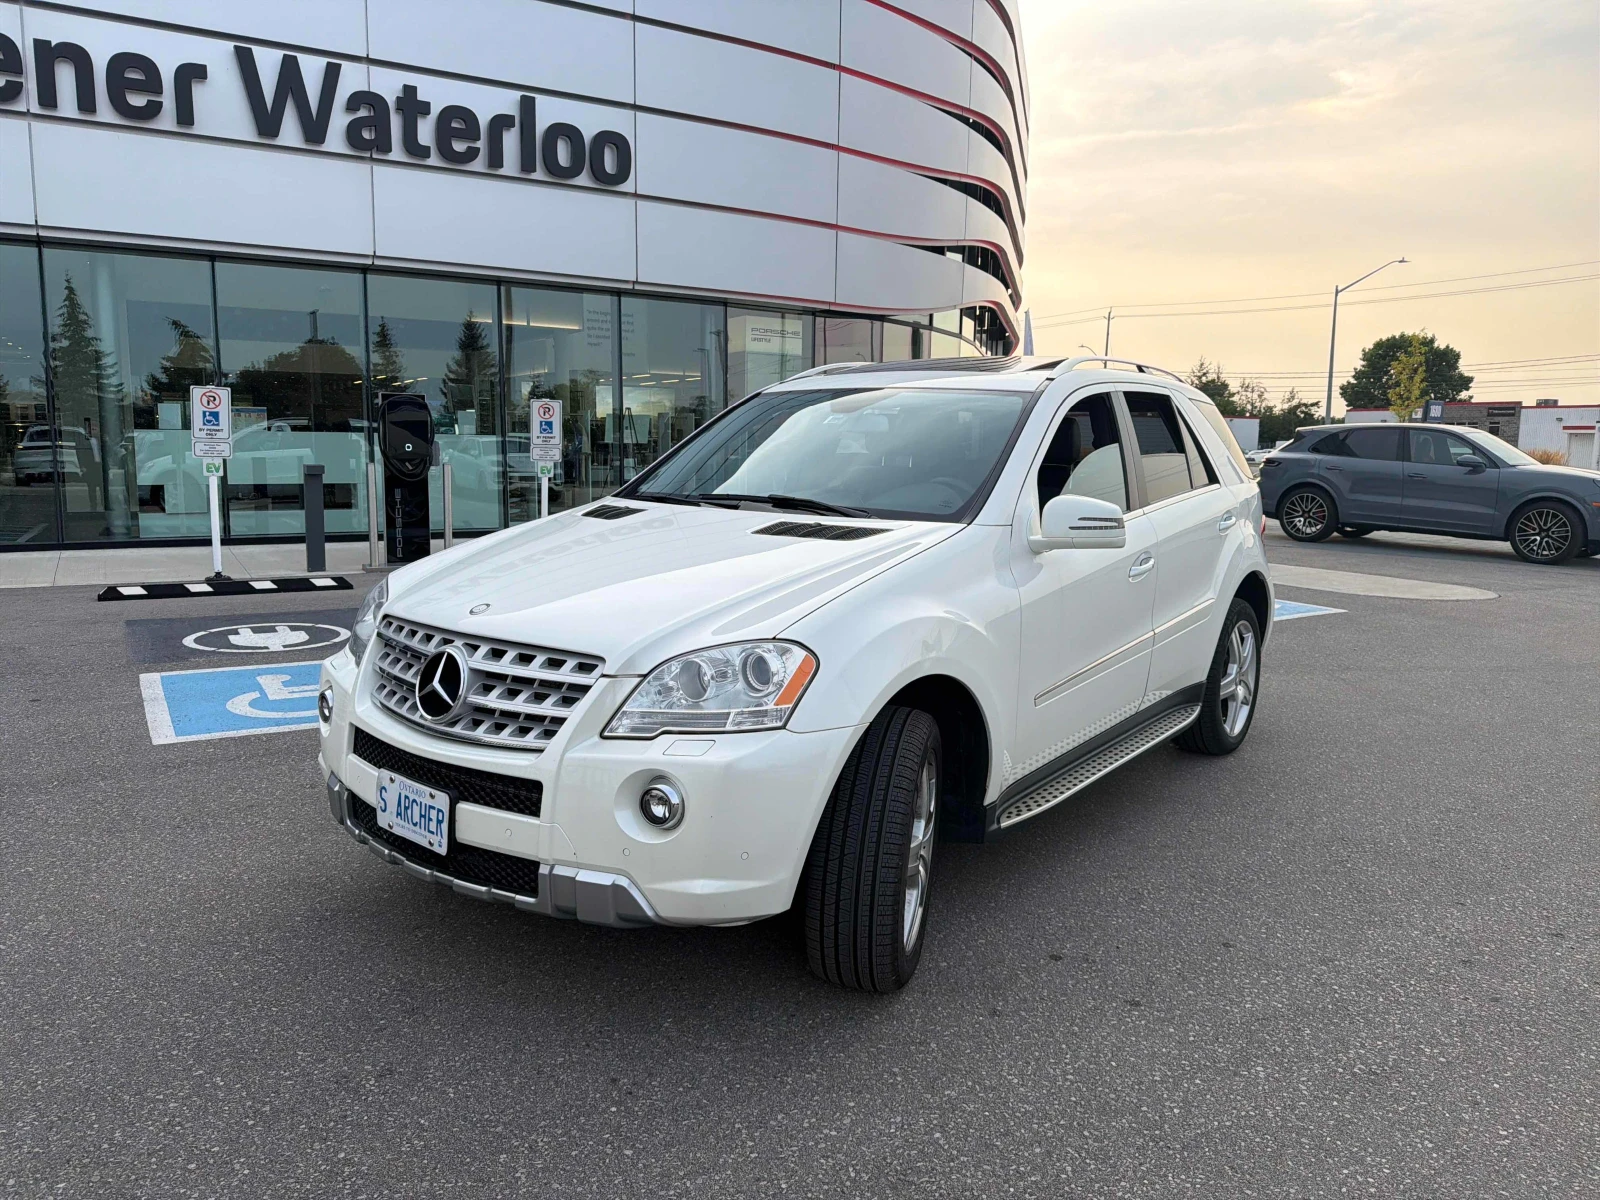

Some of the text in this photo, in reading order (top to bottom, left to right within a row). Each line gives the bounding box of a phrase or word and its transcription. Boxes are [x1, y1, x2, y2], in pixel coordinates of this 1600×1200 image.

[233, 45, 632, 187] Waterloo
[751, 327, 801, 336] PORSCHE
[206, 462, 221, 473] EV
[540, 465, 552, 475] EV
[395, 488, 403, 557] PORSCHE
[399, 781, 426, 799] ONTARIO
[380, 786, 444, 839] S ARCHER
